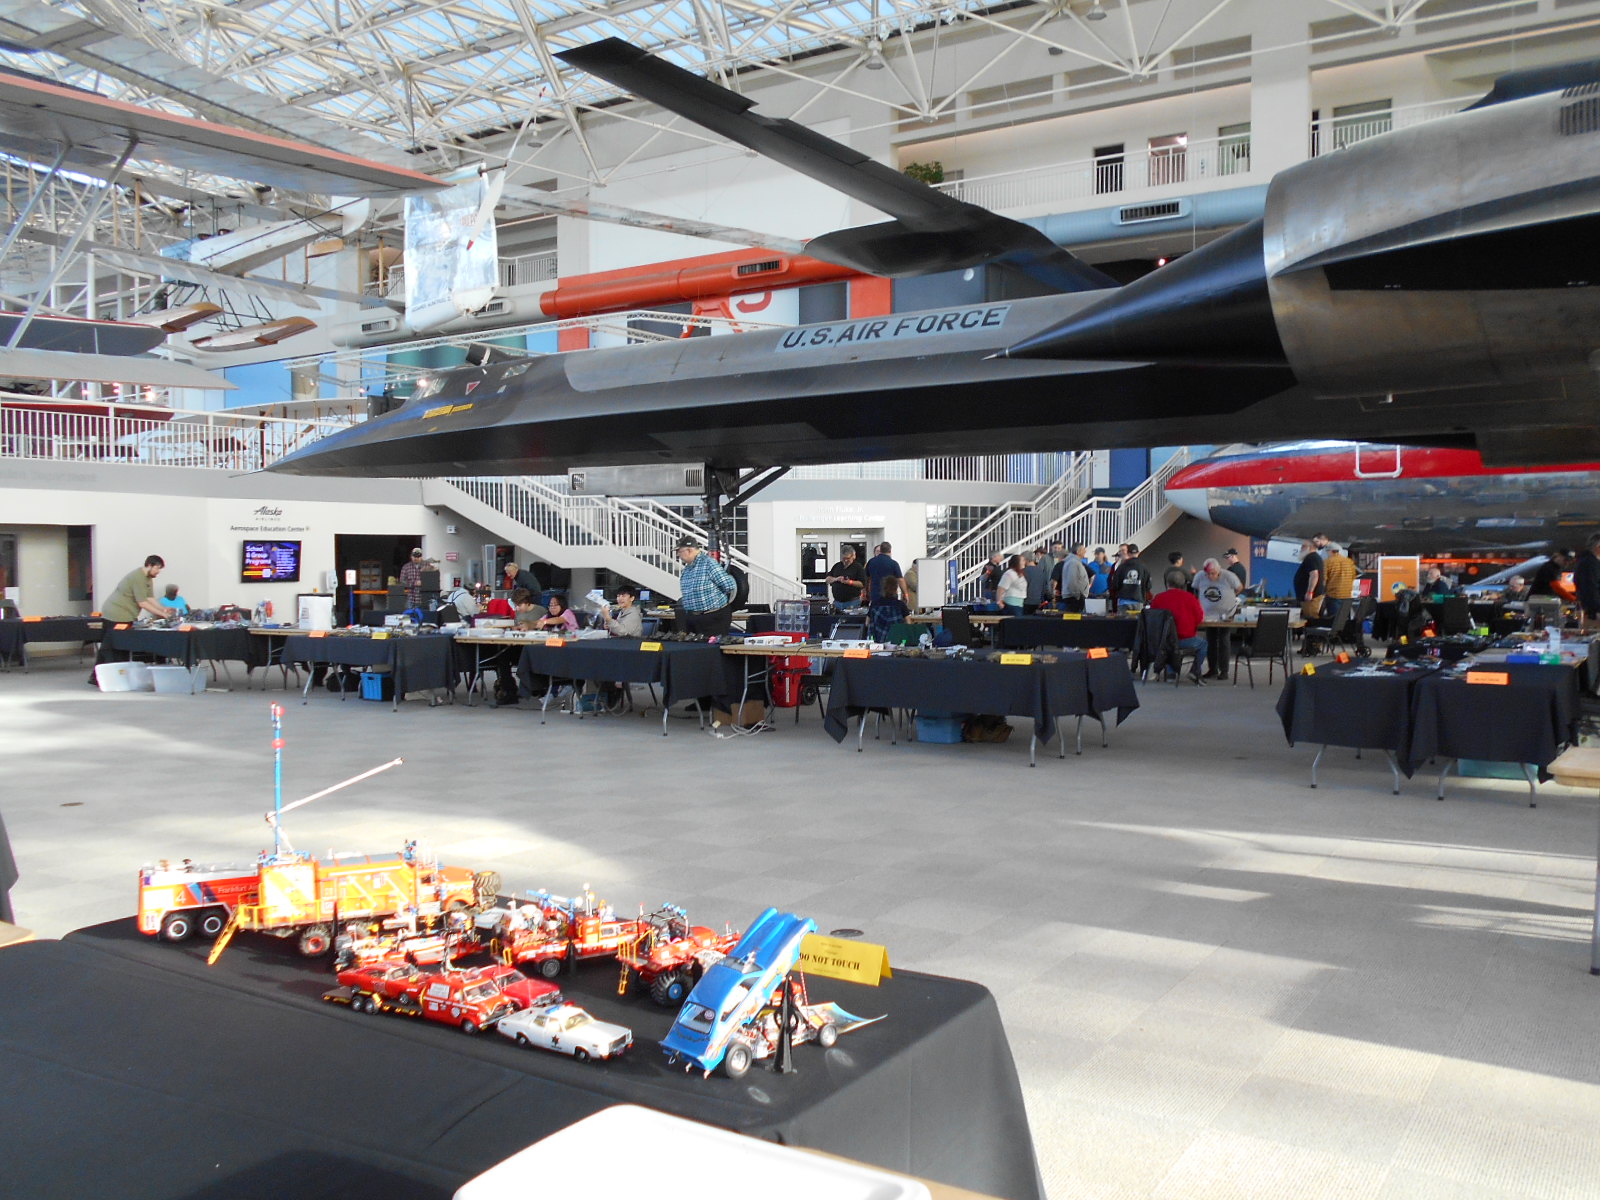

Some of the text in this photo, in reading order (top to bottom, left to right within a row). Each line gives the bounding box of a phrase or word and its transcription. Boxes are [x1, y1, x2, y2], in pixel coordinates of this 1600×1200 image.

[893, 306, 1008, 336] FORCE
[254, 505, 282, 516] Alaska
[175, 890, 187, 904] 4
[800, 952, 810, 961] DO
[812, 954, 828, 965] NOT
[832, 958, 860, 971] TOUCH
